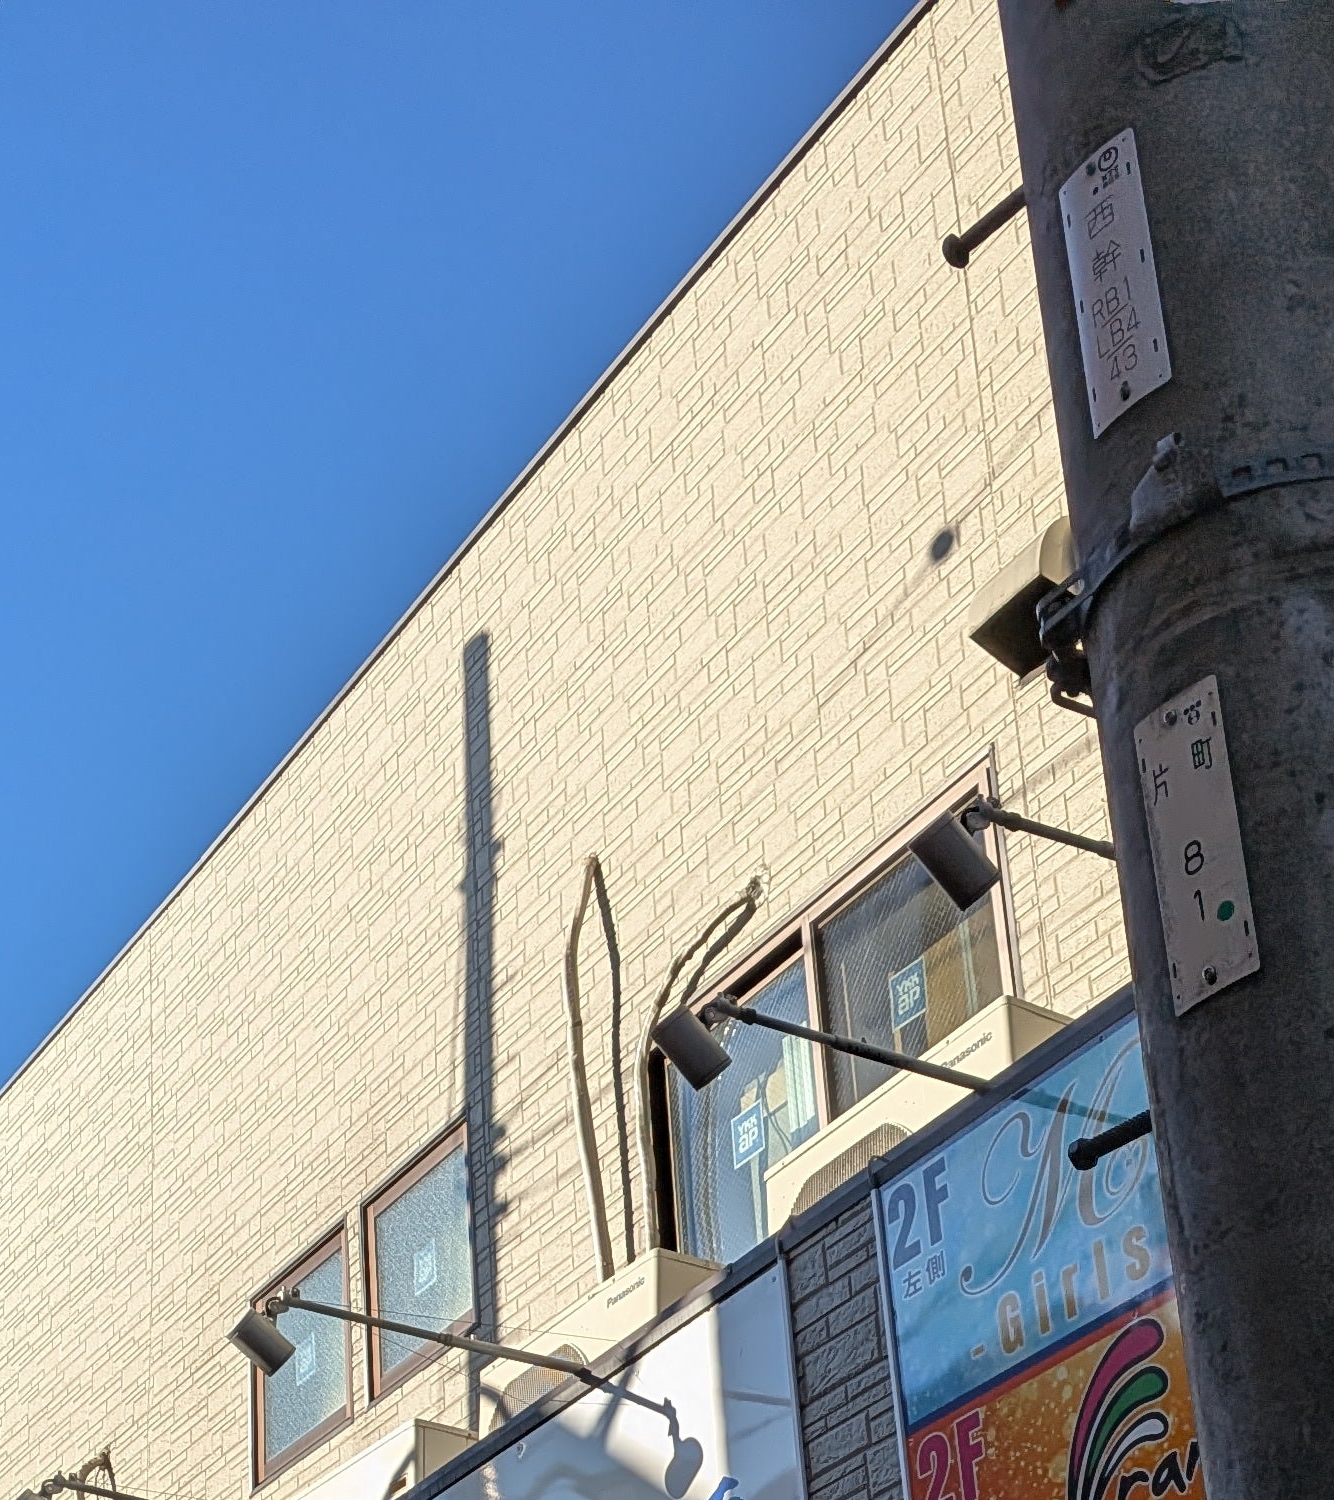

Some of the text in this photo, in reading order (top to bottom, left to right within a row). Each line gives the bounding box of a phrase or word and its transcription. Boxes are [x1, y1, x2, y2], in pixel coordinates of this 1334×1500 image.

[1091, 275, 1130, 329] RB1
[887, 1156, 949, 1271] 2F
[902, 1250, 947, 1299] 左側
